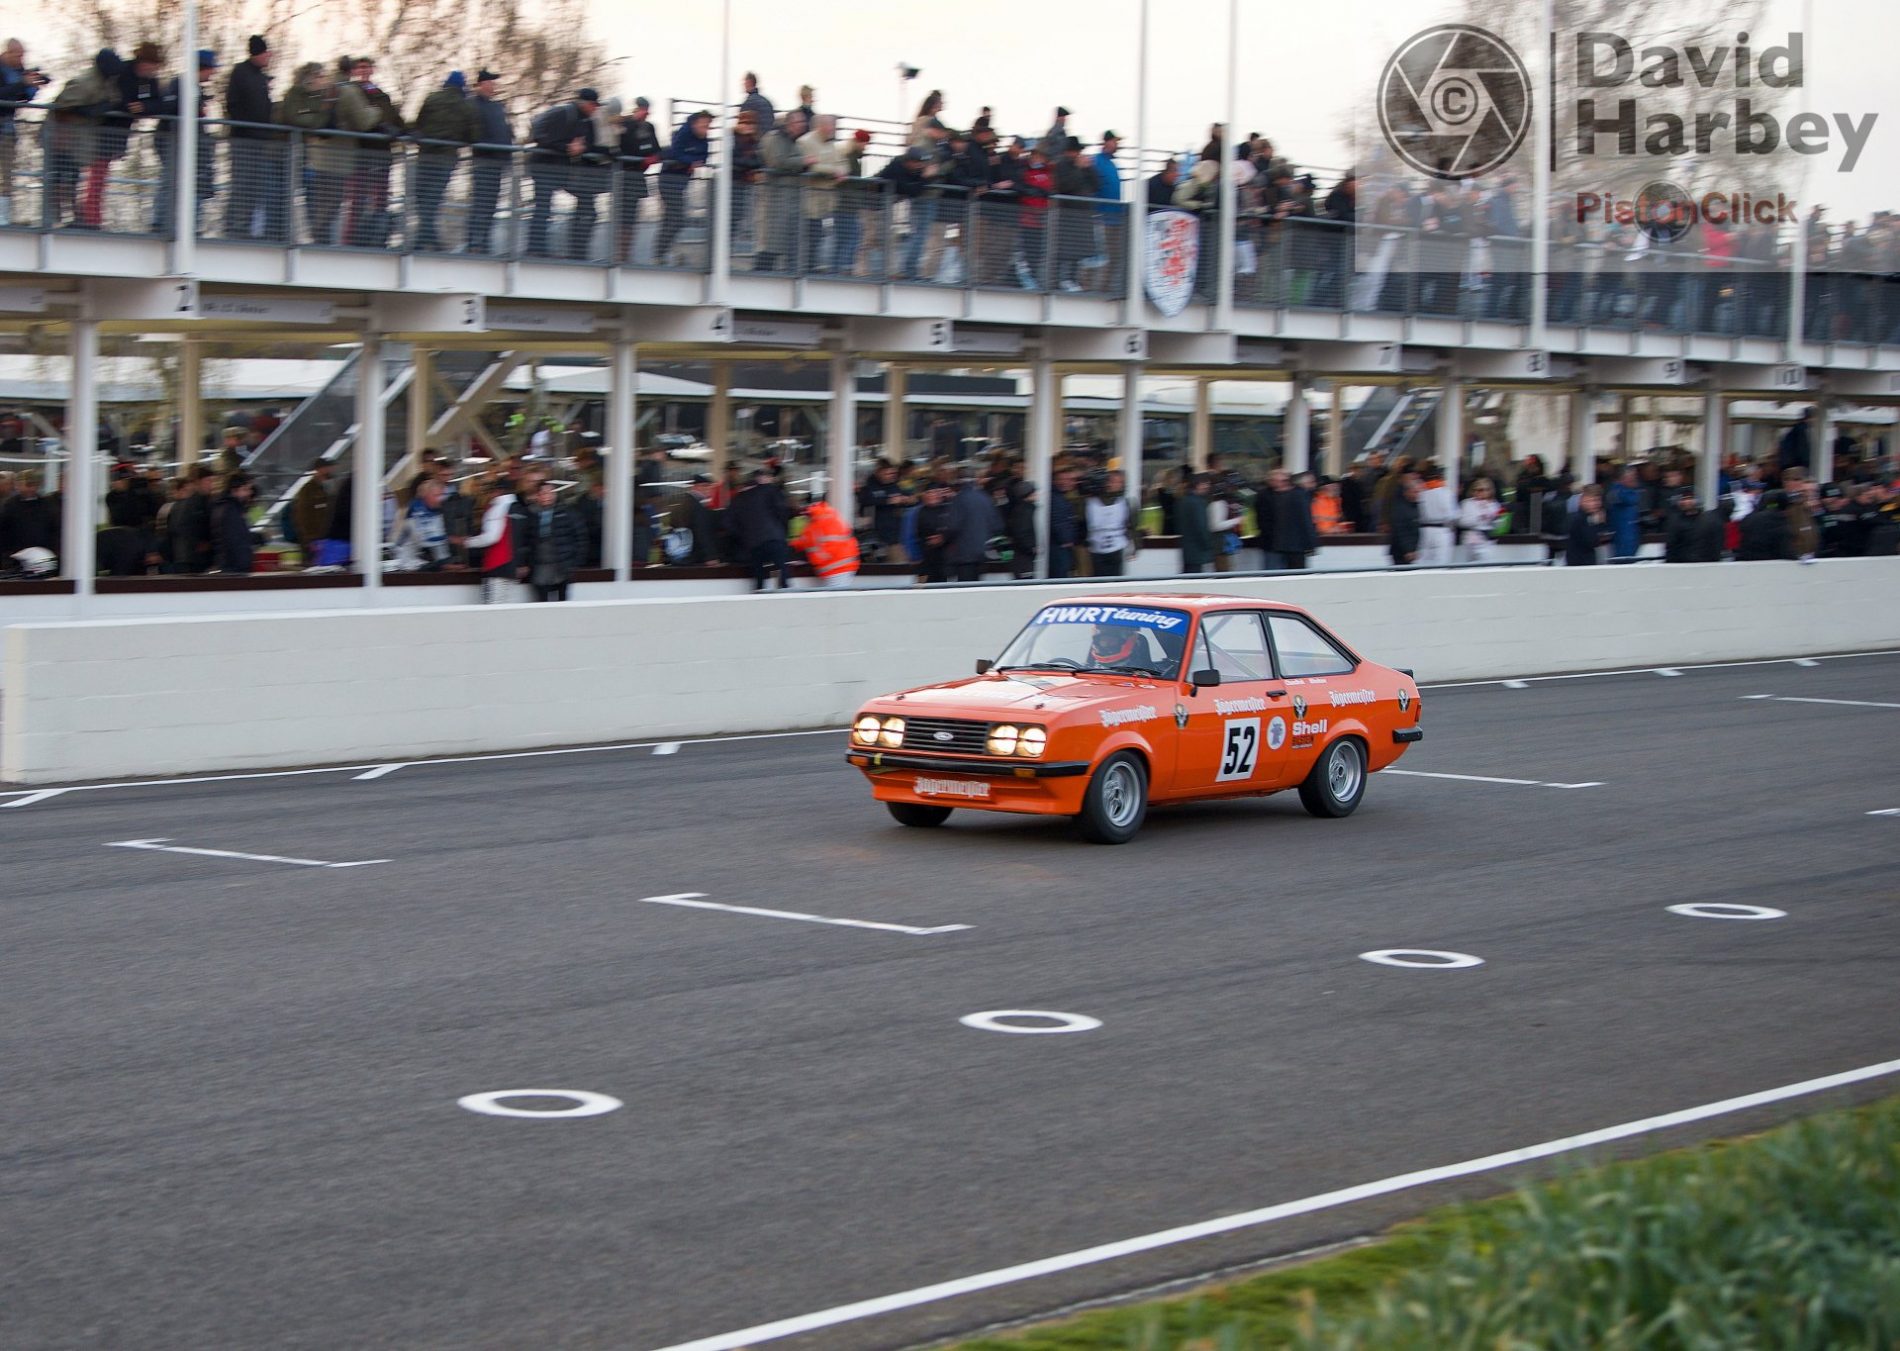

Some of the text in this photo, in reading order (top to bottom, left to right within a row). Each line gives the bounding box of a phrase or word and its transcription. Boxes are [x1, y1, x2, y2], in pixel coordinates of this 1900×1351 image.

[175, 284, 192, 312] 2
[462, 299, 479, 326] 3
[710, 309, 728, 334] 4
[1292, 719, 1328, 736] Shell
[1223, 726, 1255, 775] 52
